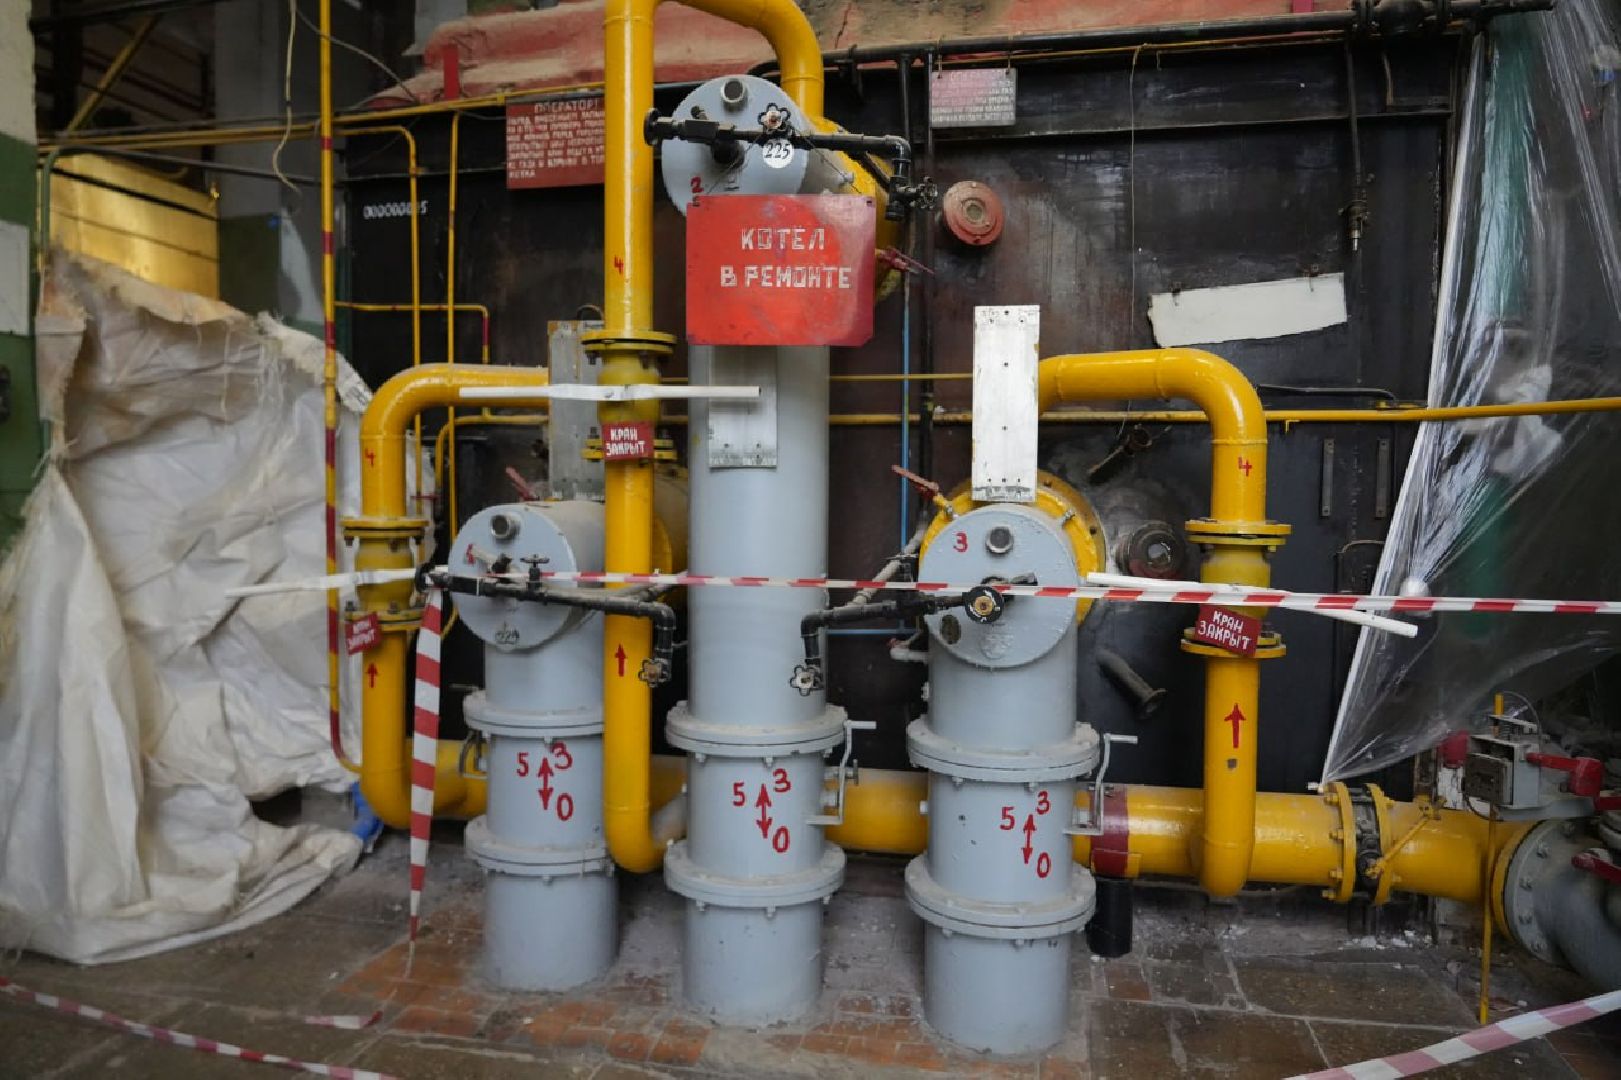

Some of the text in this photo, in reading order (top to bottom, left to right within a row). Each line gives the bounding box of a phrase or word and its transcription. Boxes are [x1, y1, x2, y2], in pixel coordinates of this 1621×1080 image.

[764, 143, 790, 159] 225
[690, 176, 704, 193] 2
[614, 255, 624, 274] 4
[720, 265, 852, 289] В РЕМОНТЕ
[610, 427, 638, 441] КРАН
[606, 440, 645, 457] ЗАКРЫТ
[1238, 456, 1253, 477] 4
[953, 532, 968, 553] 3
[1213, 610, 1244, 634] КРАН
[1198, 620, 1251, 650] ЗАКРЫТ
[516, 752, 529, 777] 5
[550, 741, 573, 770] 3
[773, 768, 792, 793] 3
[733, 782, 746, 807] 5
[1036, 790, 1051, 815] 3
[556, 793, 574, 822] 0
[1000, 806, 1016, 830] 5
[772, 826, 790, 854] 0
[1036, 852, 1052, 878] 0
